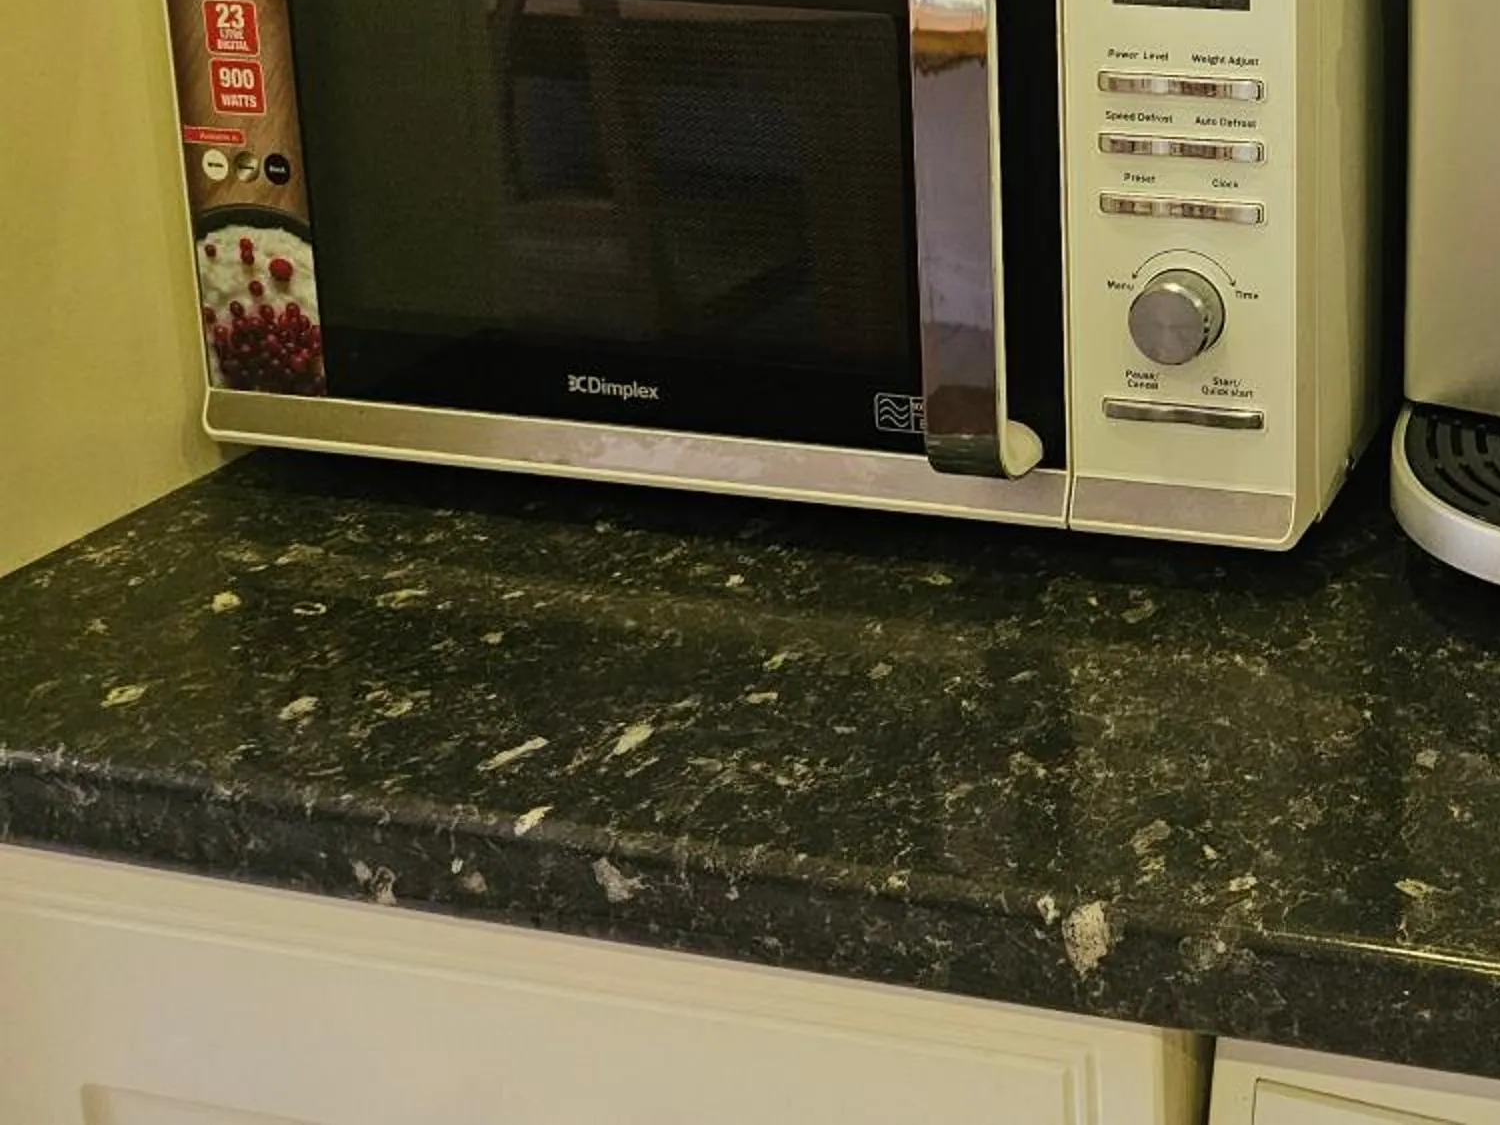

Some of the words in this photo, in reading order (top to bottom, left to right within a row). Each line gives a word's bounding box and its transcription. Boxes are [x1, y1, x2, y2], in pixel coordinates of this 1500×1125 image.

[215, 3, 245, 29] 23
[217, 39, 249, 52] DIGITAL
[1107, 48, 1139, 60] Power
[1143, 50, 1169, 61] Level
[1192, 54, 1226, 66] Weight
[1228, 56, 1260, 67] Adjust
[219, 68, 255, 89] 900
[221, 94, 257, 108] WATTS
[1105, 110, 1135, 124] Speed
[1137, 112, 1173, 124] Defrost
[1195, 116, 1218, 126] Auto
[1219, 118, 1257, 129] Defrost
[1123, 173, 1156, 184] Preset
[1107, 279, 1135, 292] Menu
[1235, 289, 1259, 300] Time
[588, 376, 660, 401] Dimplex
[1127, 379, 1160, 390] Cancel
